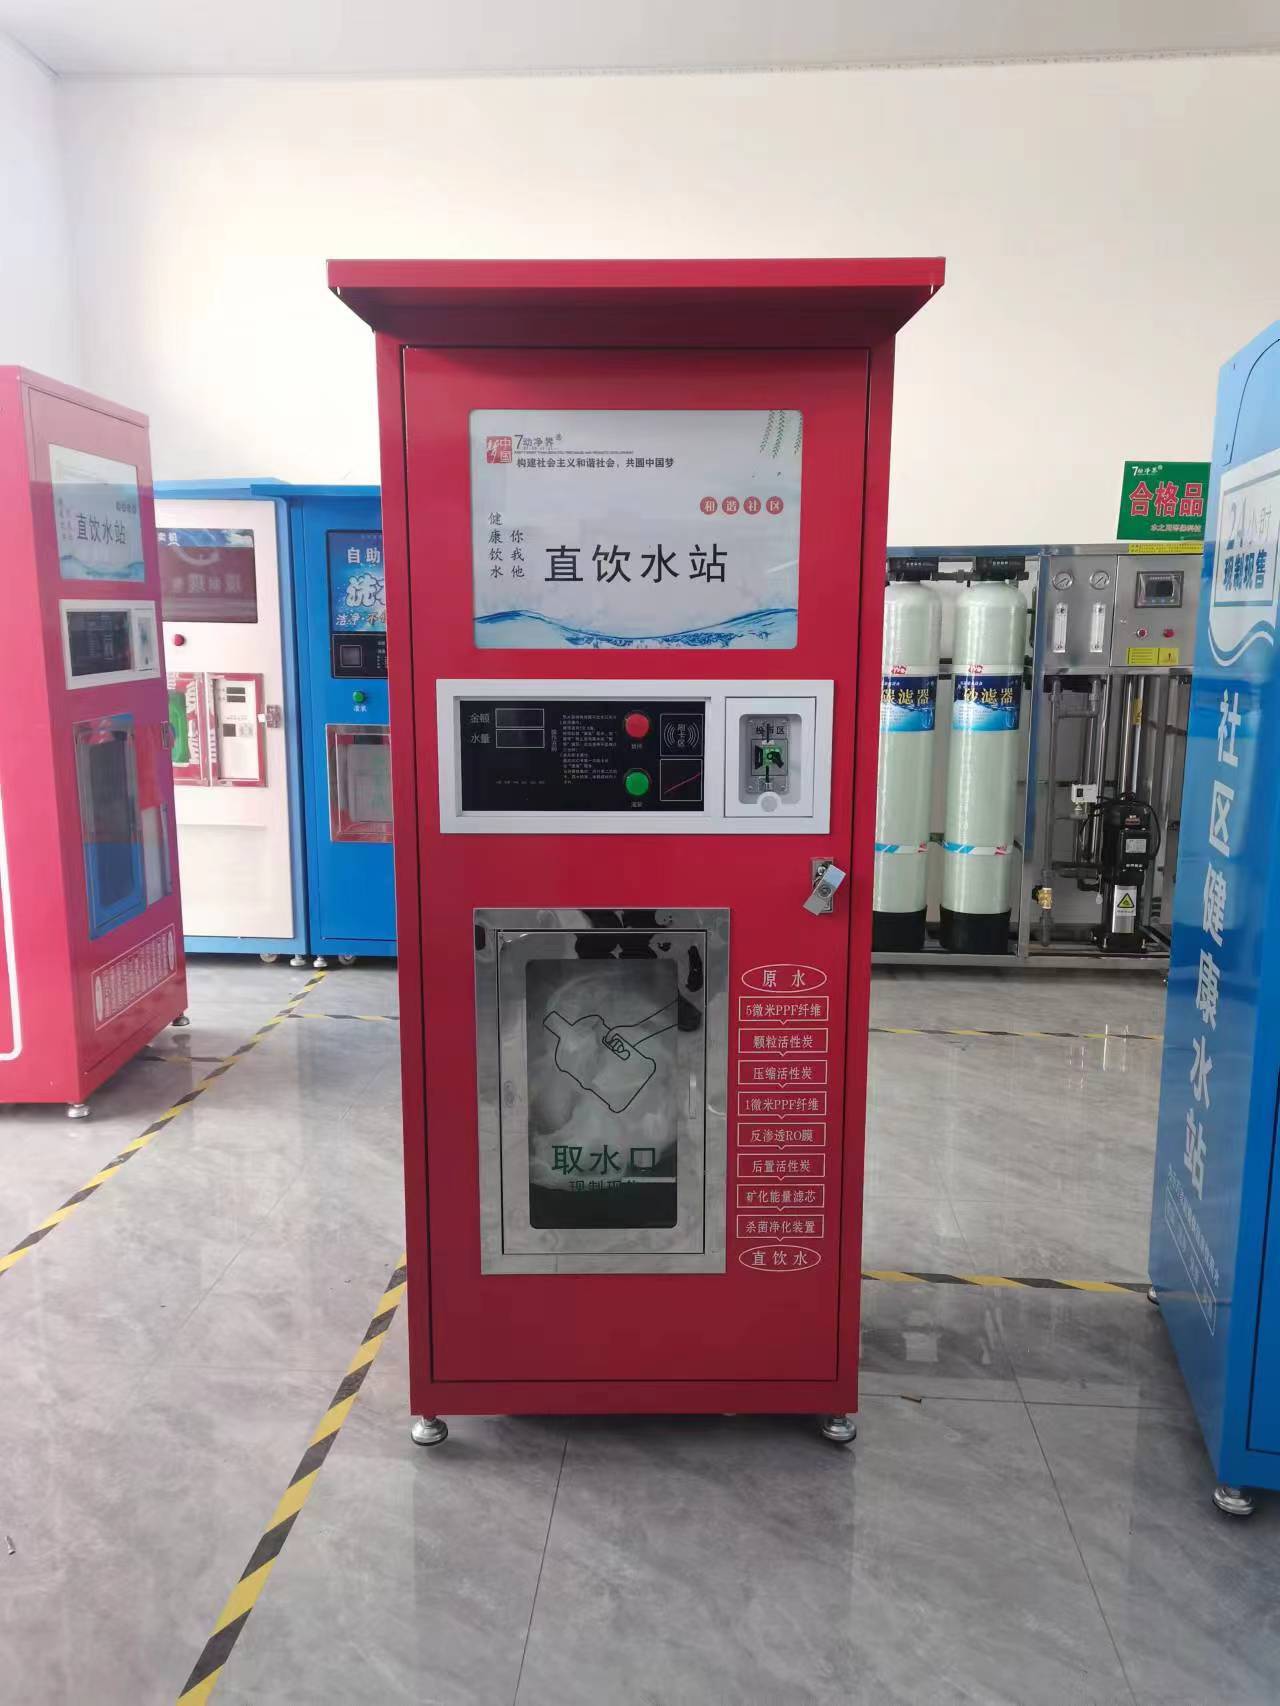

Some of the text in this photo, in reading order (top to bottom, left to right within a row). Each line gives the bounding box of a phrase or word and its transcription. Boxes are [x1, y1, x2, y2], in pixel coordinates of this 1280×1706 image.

[702, 498, 783, 514] 和谐社区
[1128, 480, 1204, 517] 合格品
[76, 512, 126, 545] 直饮水站
[488, 511, 504, 578] 健康饮水
[347, 547, 381, 564] 自助
[510, 530, 525, 578] 你我他
[544, 543, 729, 584] 直饮水站
[1223, 549, 1268, 592] 现制现售
[470, 713, 490, 724] 金额
[470, 733, 492, 744] 水量
[1183, 688, 1242, 1201] 社区健康水站
[762, 969, 806, 988] 原水
[746, 1004, 822, 1018] 5微米PPF纤维
[753, 1035, 813, 1049] 颗粒活性炭
[753, 1066, 813, 1081] 压缩活性炭
[745, 1097, 819, 1112] 1微米PPF纤维
[751, 1129, 814, 1143] 反渗透RO膜
[551, 1144, 656, 1175] 取水口
[752, 1159, 811, 1173] 后置活性炭
[746, 1190, 816, 1204] 矿化能量滤芯
[745, 1220, 815, 1234] 杀菌净化装置
[751, 1250, 808, 1266] 直饮水
